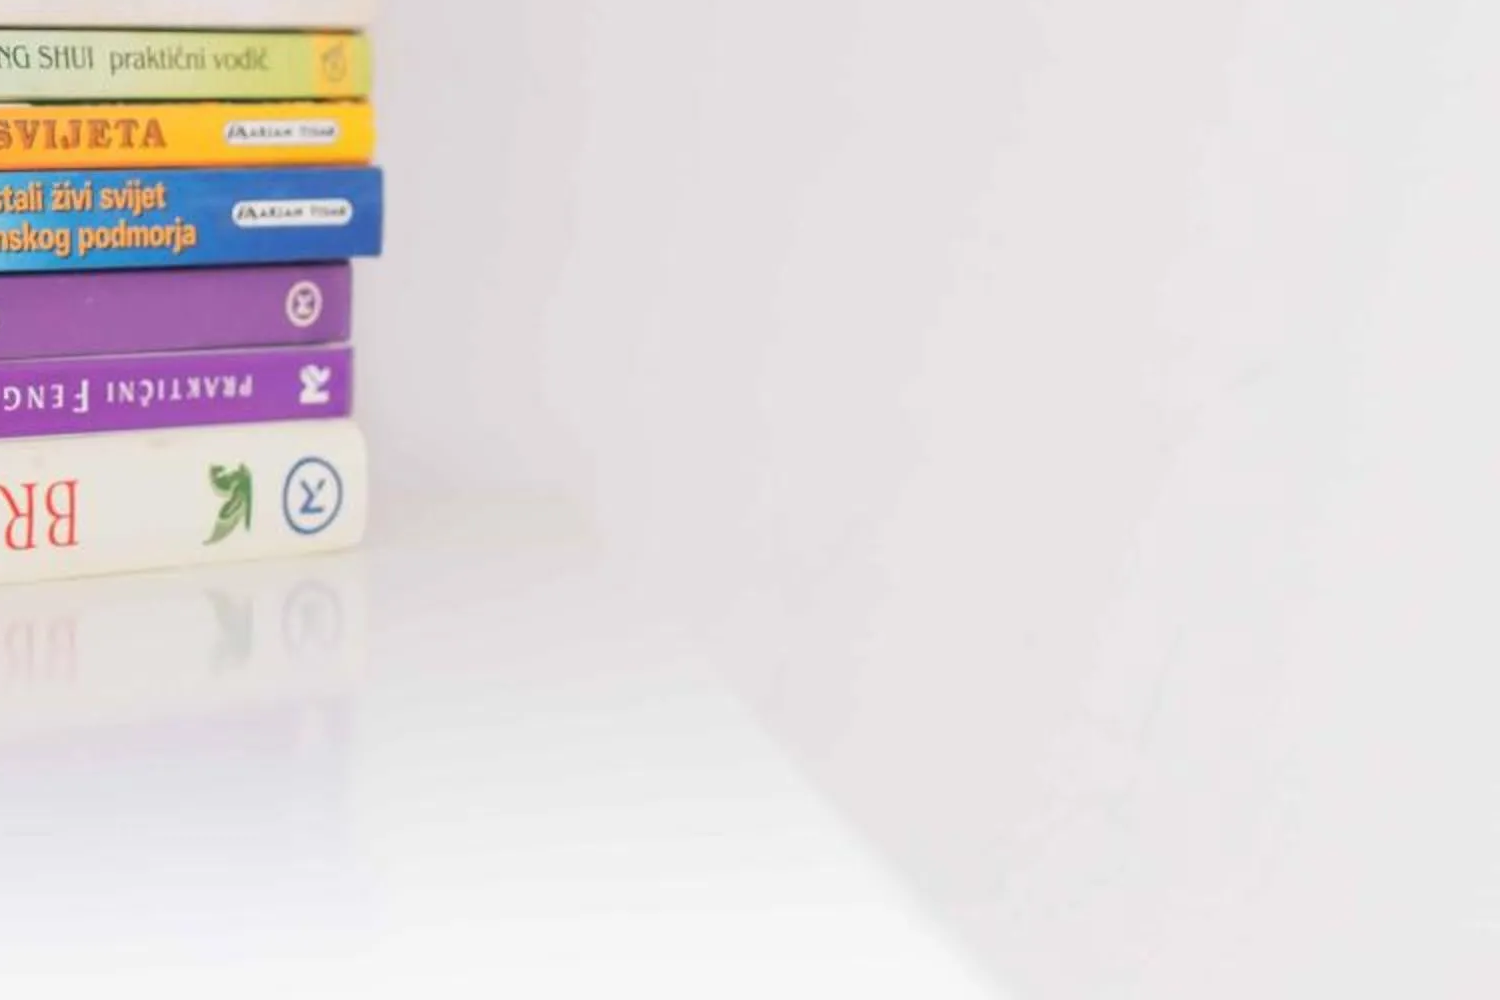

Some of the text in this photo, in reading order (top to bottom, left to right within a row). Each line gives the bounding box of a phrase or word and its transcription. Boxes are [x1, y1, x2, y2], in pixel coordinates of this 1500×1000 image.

[38, 46, 93, 69] SHUI
[51, 182, 94, 212] živi
[100, 180, 165, 215] svijet
[78, 217, 198, 256] podmorja
[4, 380, 88, 412] FENG
[108, 376, 252, 407] PRAKTIČNI
